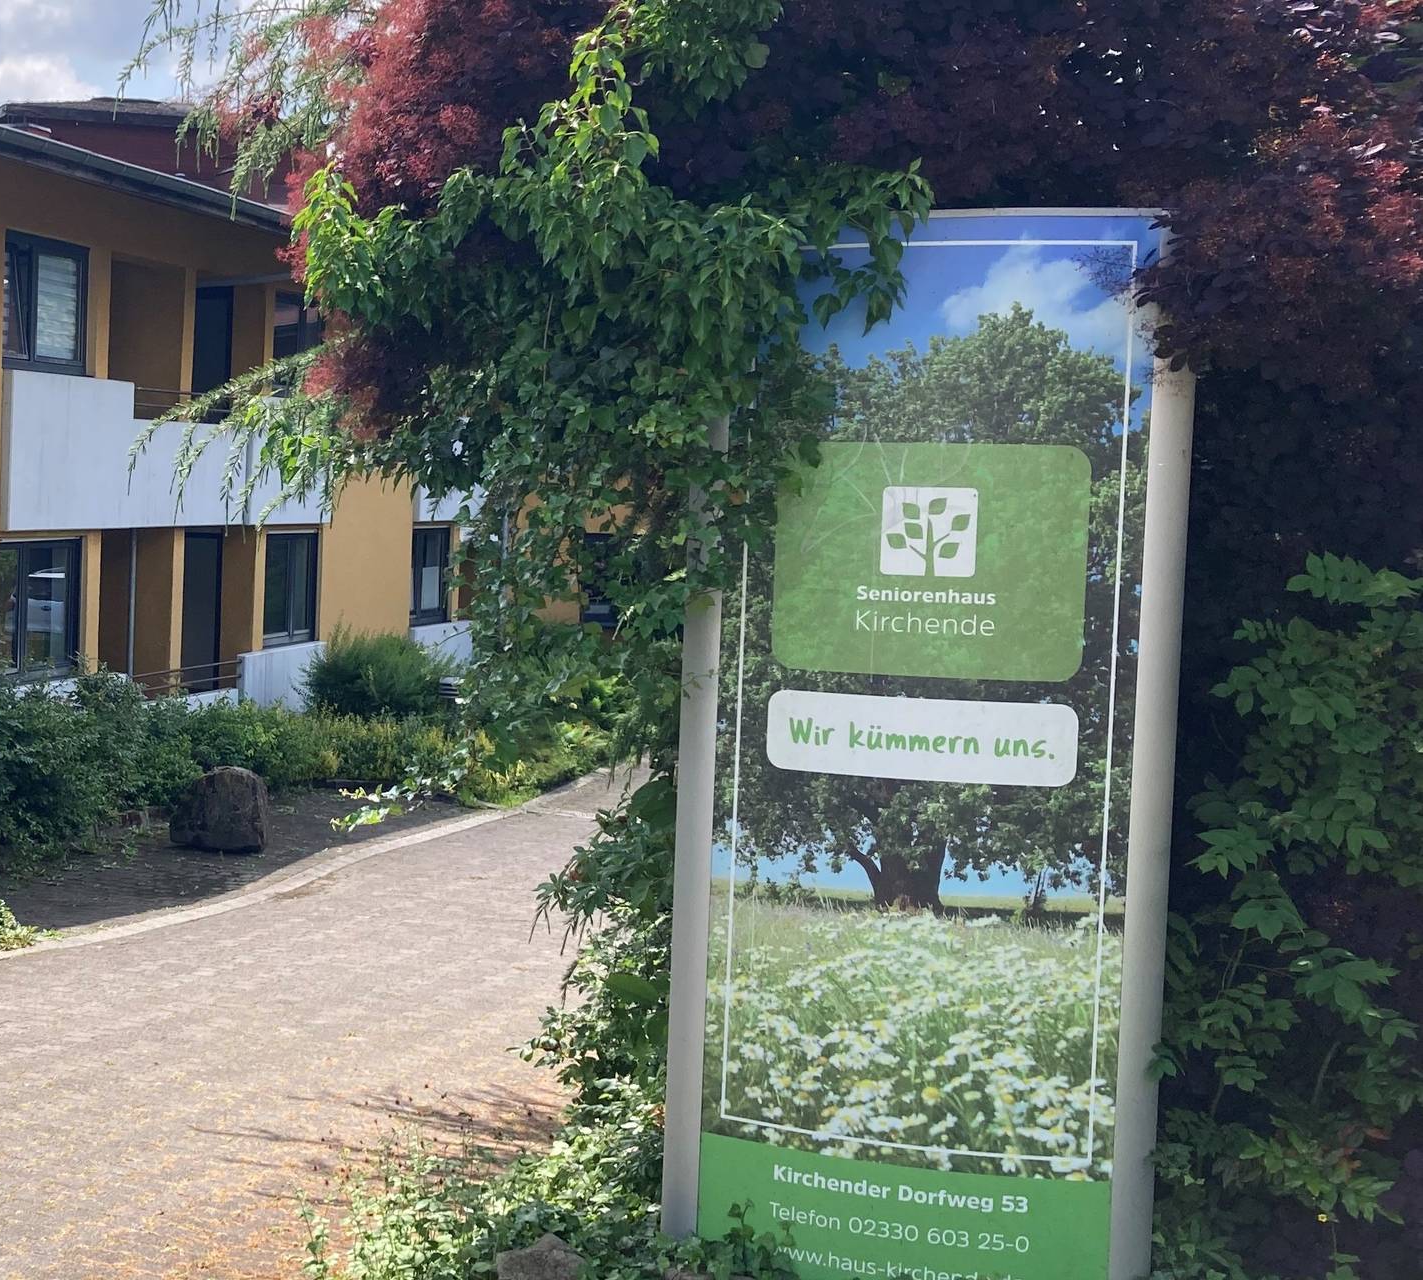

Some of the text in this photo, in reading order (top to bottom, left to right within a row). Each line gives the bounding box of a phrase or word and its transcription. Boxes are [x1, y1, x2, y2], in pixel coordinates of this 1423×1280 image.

[856, 585, 996, 605] Seniorenhaus
[856, 609, 995, 636] Kirchende
[789, 717, 1055, 760] Wir kümmern uns.
[773, 1164, 1029, 1213] Kirchender Dorfweg 53
[769, 1201, 1030, 1253] Telefon 02330 603 25-0
